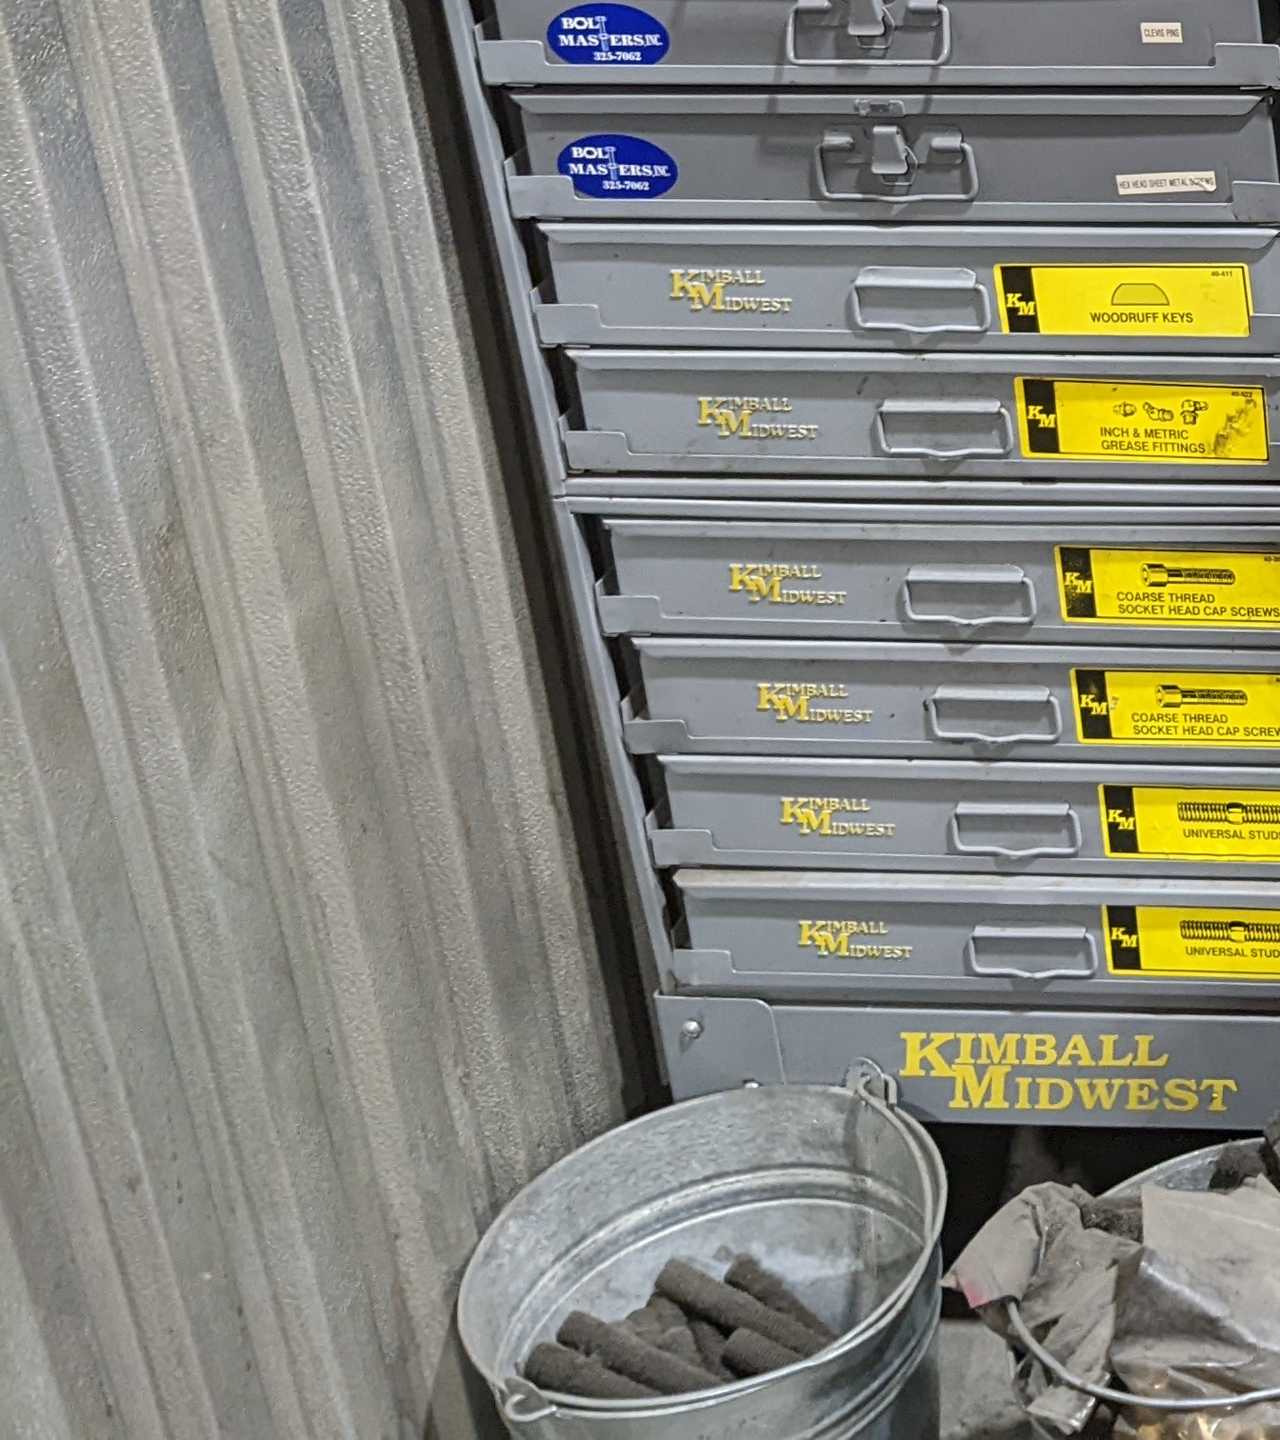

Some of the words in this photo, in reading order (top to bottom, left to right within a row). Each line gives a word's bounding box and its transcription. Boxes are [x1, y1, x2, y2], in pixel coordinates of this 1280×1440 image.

[670, 269, 766, 299] KIMBALL
[691, 283, 792, 312] MIDWEST
[1090, 312, 1159, 323] WOODRUFF
[1162, 312, 1194, 323] KEYS
[1100, 427, 1129, 438] INCH
[1132, 428, 1141, 438] &
[1143, 428, 1189, 440] METRIC
[1101, 440, 1149, 452] GREASE
[1152, 442, 1205, 453] FITTINGS
[729, 563, 822, 592] KIMBALL
[749, 576, 847, 603] MIDWEST
[1117, 592, 1166, 603] COARSE
[1168, 592, 1216, 604] THREAD
[1118, 604, 1166, 615] SOCKET
[1168, 605, 1201, 616] HEAD
[1203, 606, 1228, 616] CAP
[1231, 607, 1280, 618] SCREWS
[1183, 829, 1245, 839] UNIVERSAL
[900, 1031, 1169, 1079] KIMBALL
[948, 1064, 1237, 1112] MIDWEST
